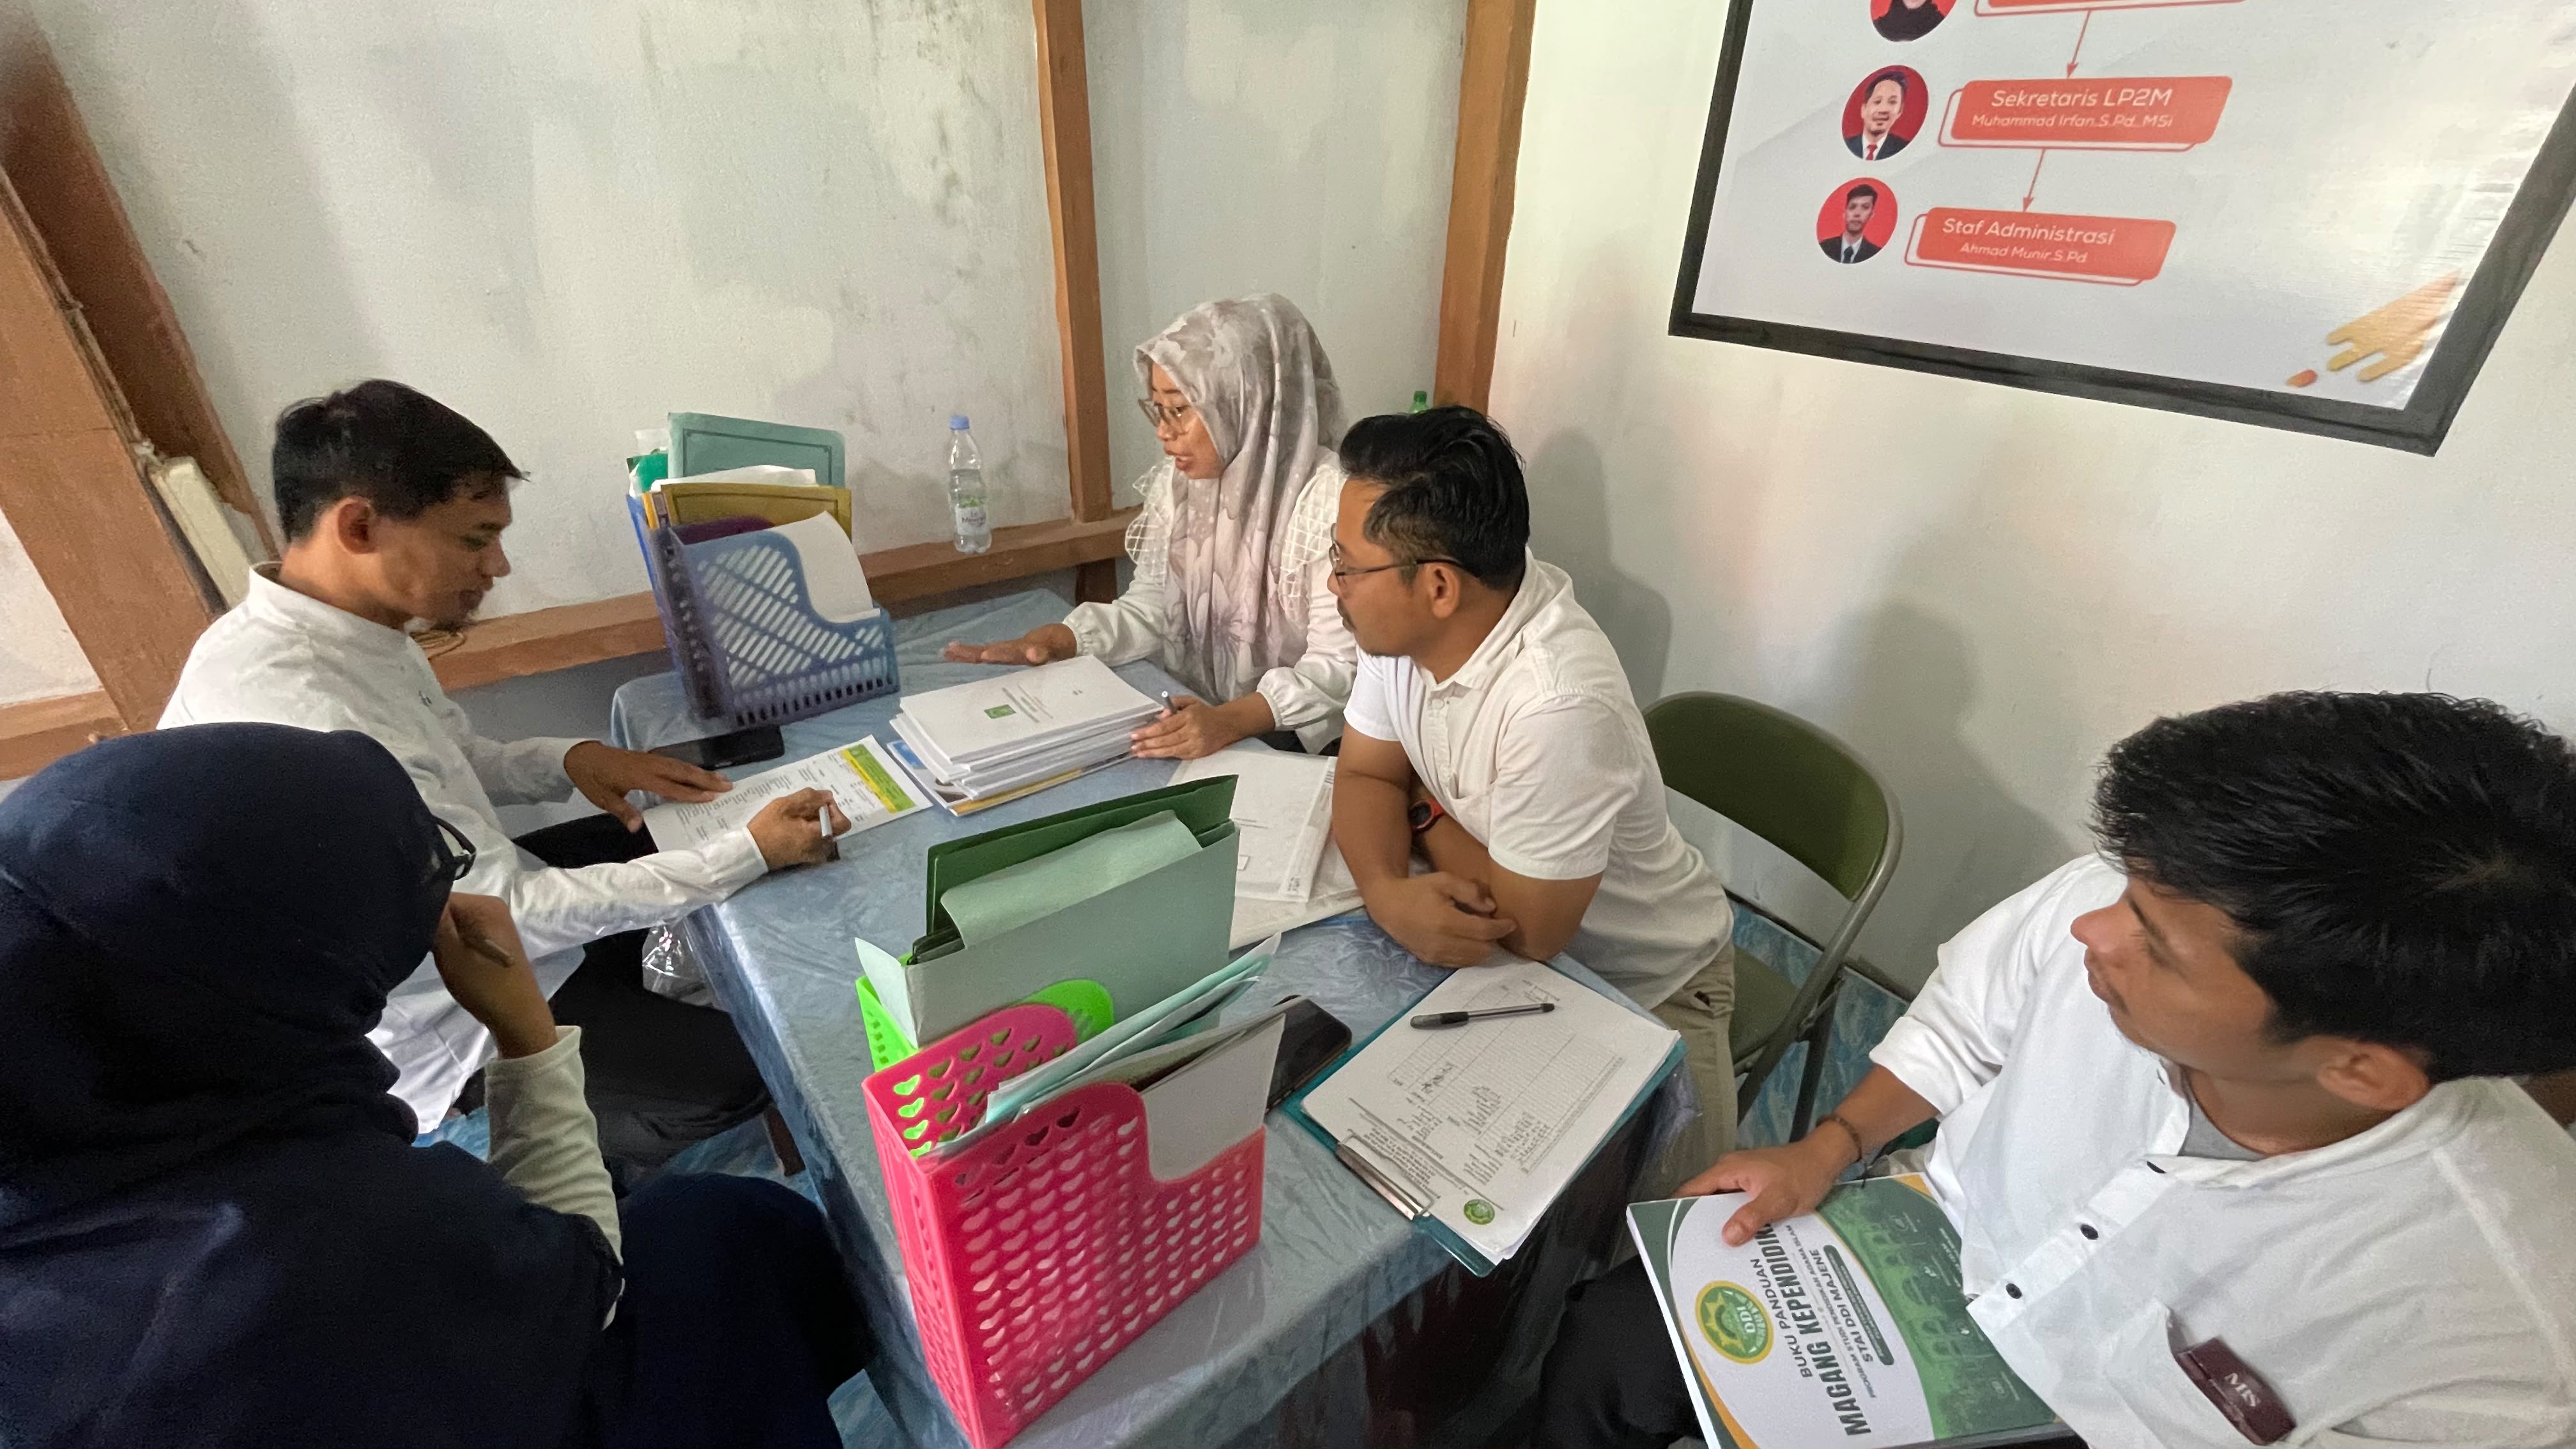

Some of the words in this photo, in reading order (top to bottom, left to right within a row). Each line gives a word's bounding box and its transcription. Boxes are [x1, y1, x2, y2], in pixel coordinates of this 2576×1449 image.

[1991, 89, 2097, 107] Sekretaris
[2103, 88, 2173, 107] LP2M
[1972, 114, 2055, 126] Muhammad
[1942, 218, 1984, 235] Staf
[1985, 221, 2116, 245] Administrasi
[1960, 242, 2009, 257] Ahmad
[1786, 1225, 1802, 1246] ISLAM
[1798, 1248, 1817, 1275] AGAMA
[1809, 1249, 1843, 1301] MAJENE
[1755, 1223, 1823, 1335] KEPENDIDIK
[1751, 1259, 1791, 1329] PANDUAN
[1813, 1277, 1840, 1325] PENDIDIKAN
[1837, 1304, 1856, 1327] DDI
[1837, 1327, 1854, 1351] STUDI
[1851, 1331, 1873, 1362] STAI
[1784, 1335, 1813, 1377] BUKU
[1807, 1341, 1871, 1436] MAGANG
[1850, 1354, 1876, 1398] PROGRAM
